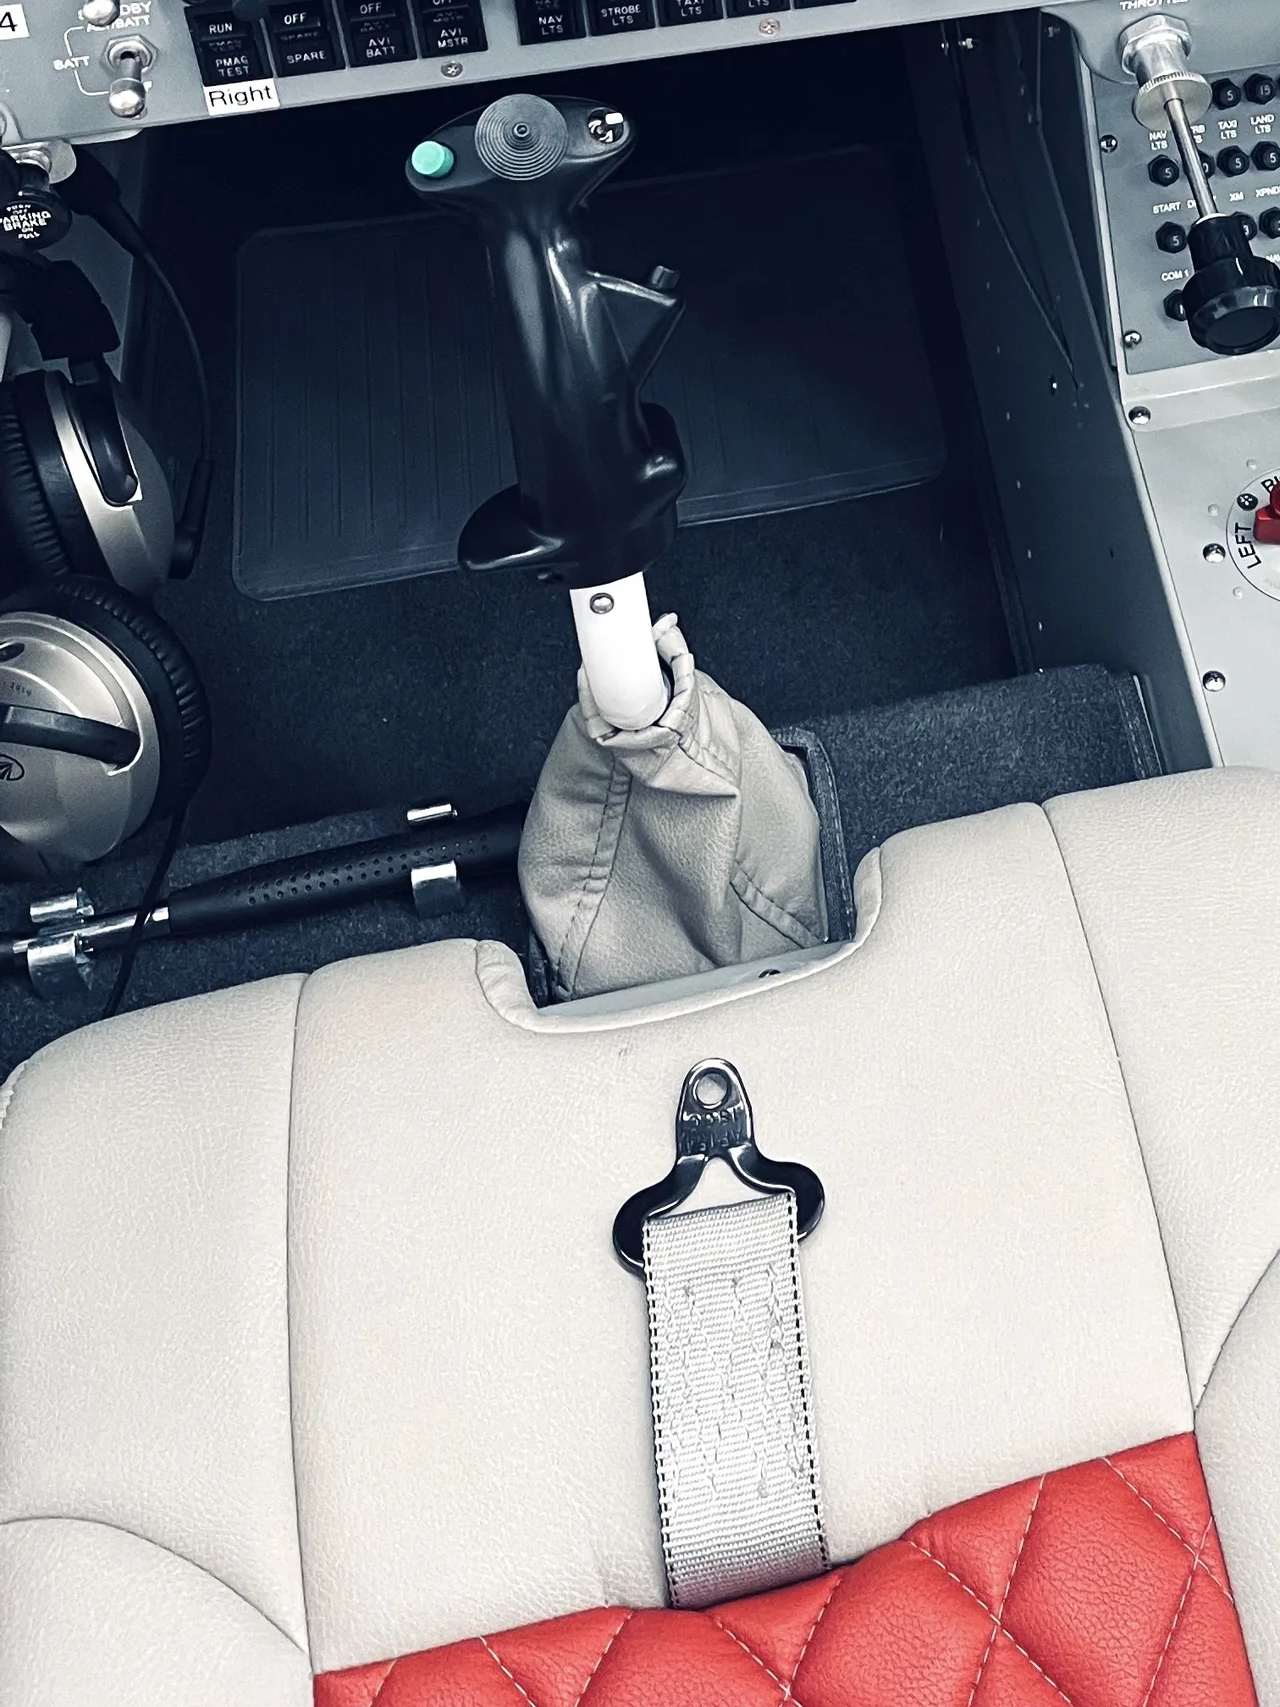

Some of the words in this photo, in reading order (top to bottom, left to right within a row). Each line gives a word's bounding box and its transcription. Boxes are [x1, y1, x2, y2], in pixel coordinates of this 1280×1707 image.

[360, 2, 382, 14] OFF
[601, 5, 640, 18] STROBE
[680, 5, 702, 16] LTS
[284, 12, 306, 24] OFF
[539, 15, 563, 27] NAV
[612, 15, 634, 26] LTS
[209, 23, 232, 33] RUN
[441, 28, 461, 40] AVI
[541, 23, 563, 34] LTS
[369, 37, 390, 49] AVI
[437, 37, 468, 49] MSTR
[287, 49, 326, 62] SPARE
[366, 46, 395, 58] BATT
[53, 56, 89, 70] BATT
[216, 57, 249, 69] PMAG
[218, 65, 249, 76] TEST
[209, 84, 272, 107] Right
[1219, 120, 1239, 131] TAXI
[1250, 114, 1274, 127] LAND
[1221, 128, 1237, 138] LTS
[1254, 124, 1271, 134] LTS
[1149, 131, 1168, 141] NAV
[1150, 138, 1168, 150] LTS
[1153, 201, 1181, 214] START
[1234, 522, 1260, 569] LEFT
